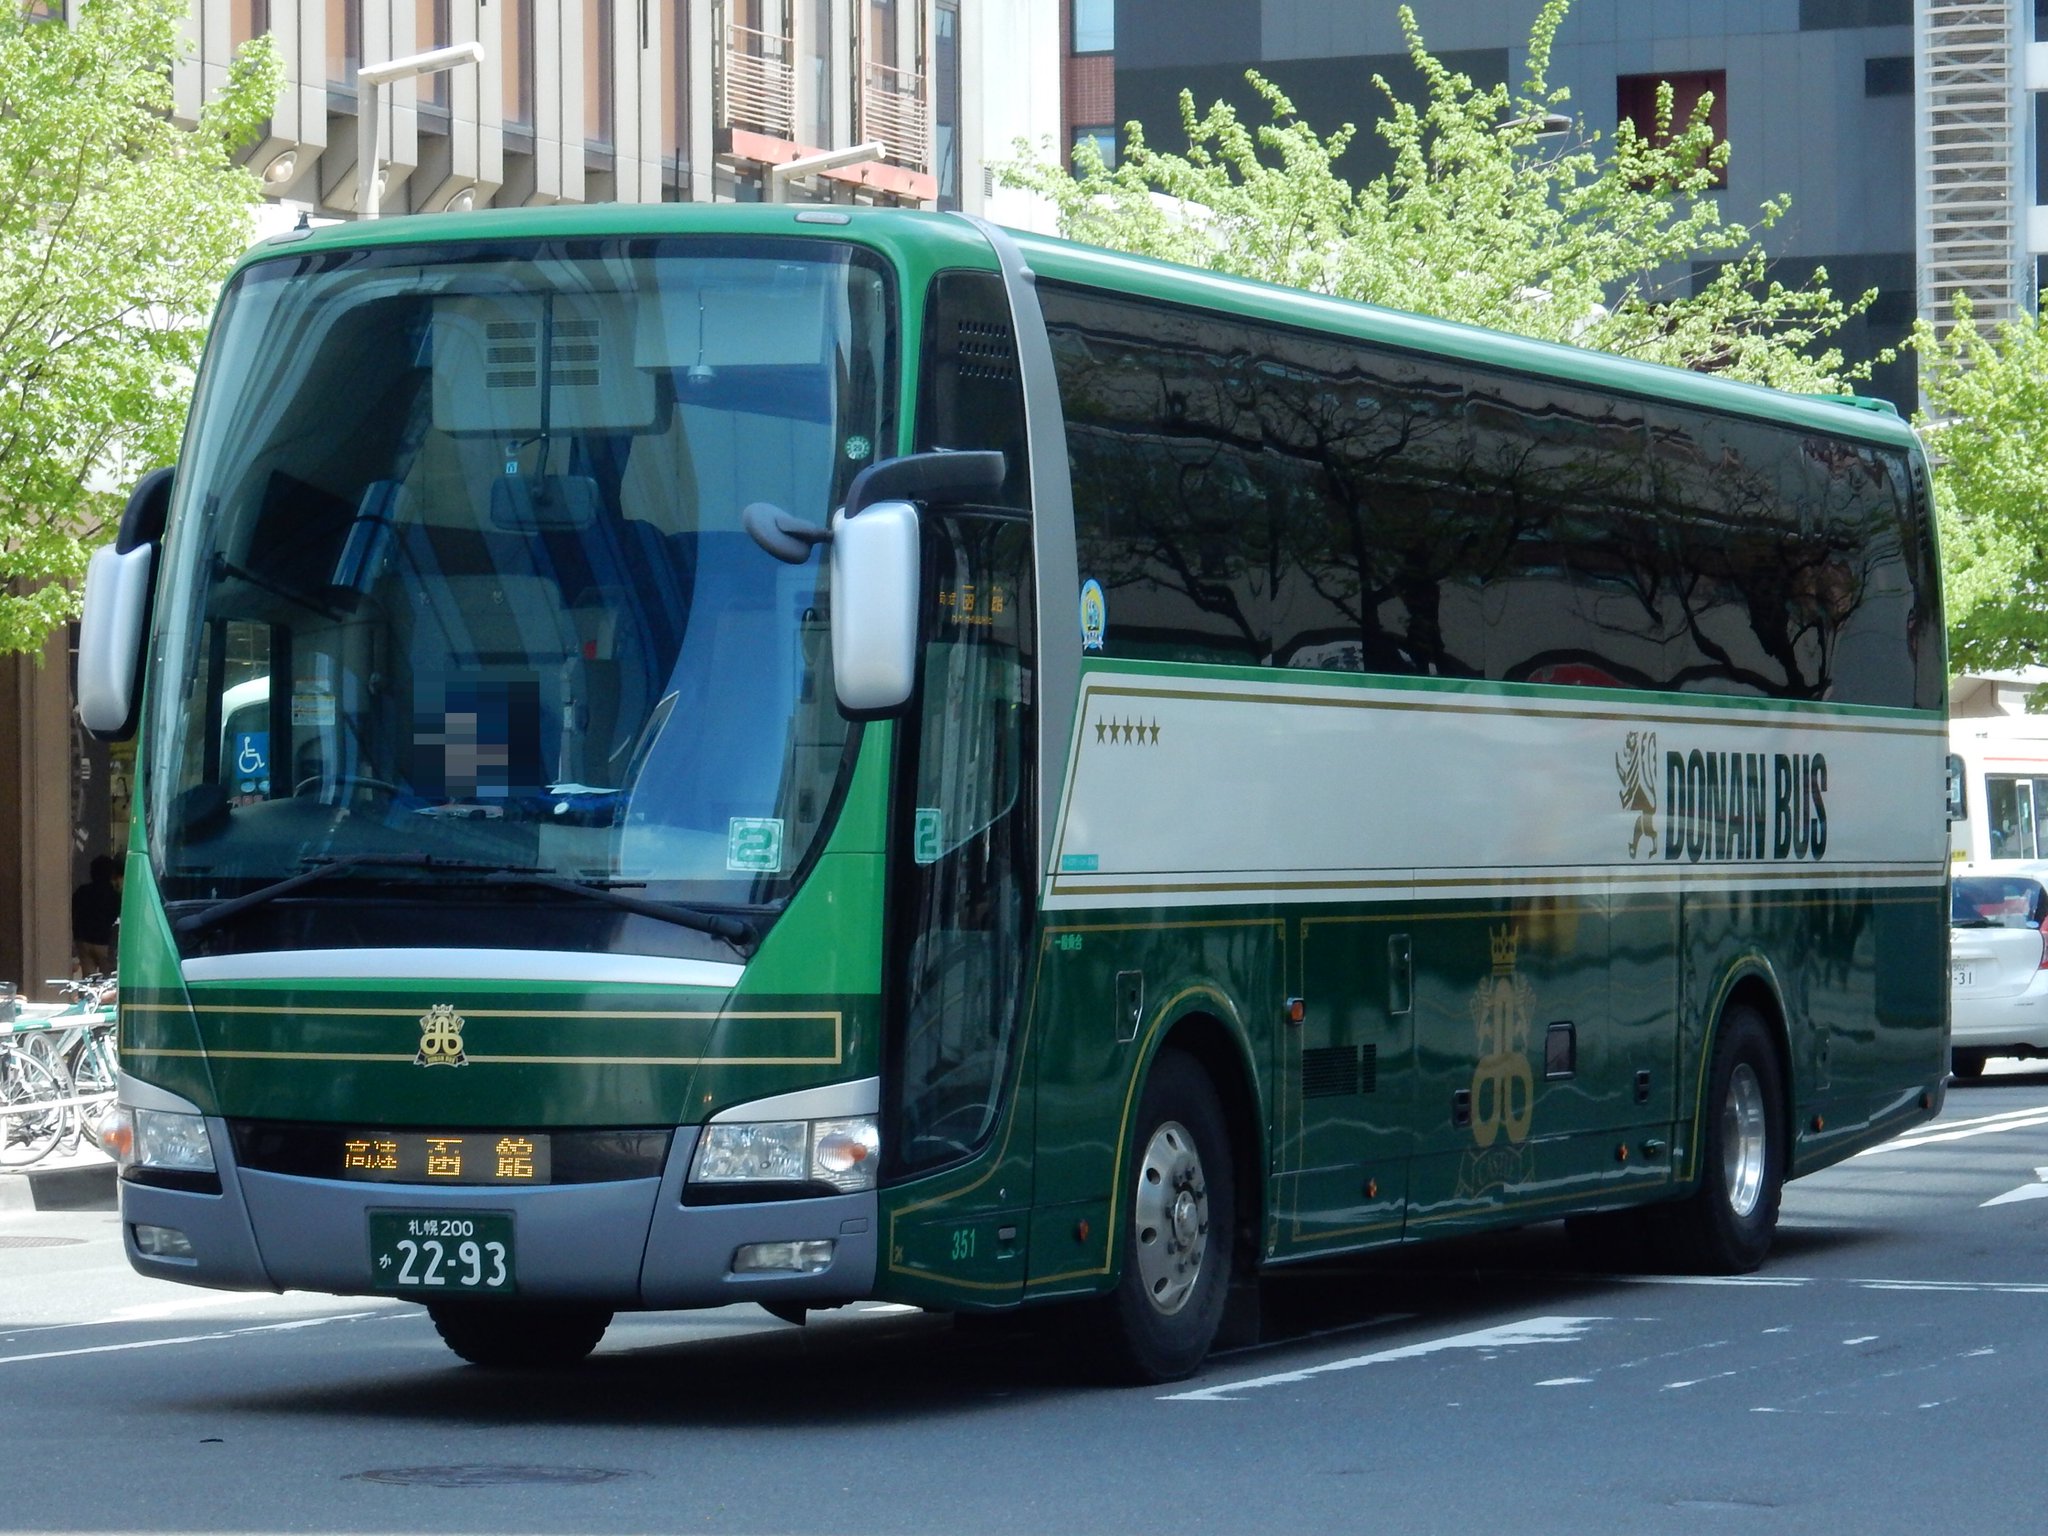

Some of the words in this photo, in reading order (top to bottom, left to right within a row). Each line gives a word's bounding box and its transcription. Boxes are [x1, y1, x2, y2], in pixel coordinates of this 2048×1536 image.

[1665, 749, 1767, 863] DONAN
[1774, 752, 1828, 861] BUS
[737, 828, 772, 863] 2
[379, 1253, 392, 1269] か
[397, 1239, 507, 1287] 22-93
[952, 1228, 976, 1260] 351
